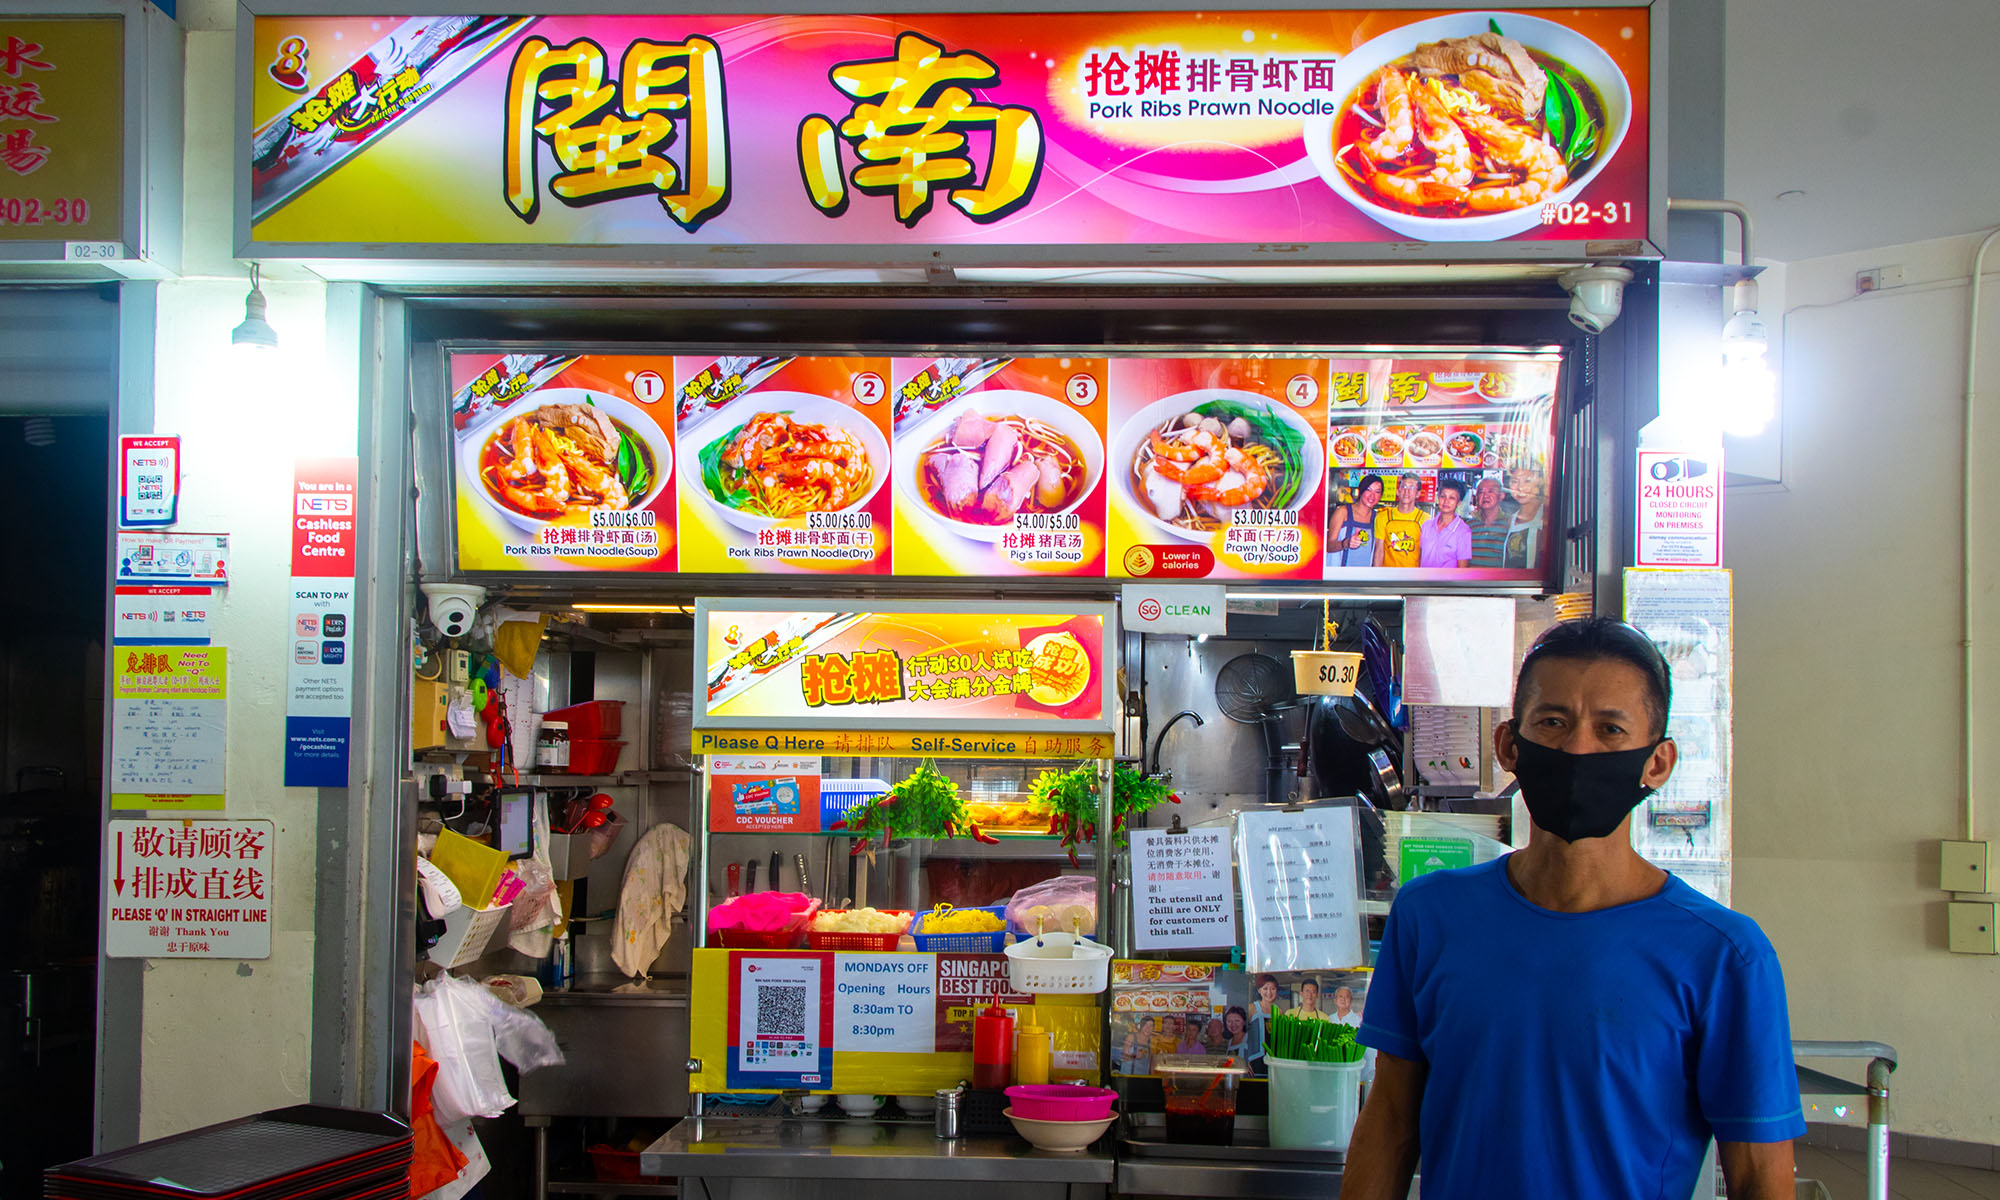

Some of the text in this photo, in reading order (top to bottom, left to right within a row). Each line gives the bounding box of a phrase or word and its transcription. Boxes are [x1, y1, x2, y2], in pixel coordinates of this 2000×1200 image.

[288, 66, 420, 133] 抢摊大行动
[1090, 98, 1334, 118] Pork Ribs Prawn Noodle
[1540, 202, 1632, 226] #02-31
[74, 244, 116, 258] 02-30
[643, 380, 652, 396] 1
[864, 381, 875, 396] 2
[1076, 382, 1088, 398] 3
[1296, 383, 1308, 399] 4
[298, 482, 316, 491] You
[336, 482, 345, 491] in
[1644, 485, 1714, 498] 24 HOURS
[302, 498, 348, 511] NETS
[296, 518, 352, 530] Cashless
[593, 512, 654, 528] $5.00/$6.00
[810, 513, 871, 529] $5.00/$6.00
[1016, 514, 1078, 530] $4.00/$5.00
[1234, 510, 1296, 526] $3.00/$4.00
[308, 532, 340, 543] Food
[1228, 529, 1300, 542] 虾面(干/汤)
[301, 545, 346, 557] Centre
[506, 546, 658, 557] Pork Ribs Prawn Noodle(Soup)
[729, 548, 873, 559] Pork Ribs Prawn Noodle(Dry)
[1226, 543, 1299, 553] Prawn Noodle
[1010, 550, 1082, 561] Pig's Tail Soup
[1162, 552, 1200, 560] Lower in
[1244, 552, 1299, 563] (Dry/Soup)
[1162, 561, 1199, 569] calories
[1141, 604, 1210, 616] SG CLEAN
[126, 652, 173, 675] 免排队
[908, 648, 1034, 677] 行动30人试吃
[802, 650, 903, 706] 抢摊
[1319, 664, 1354, 683] $0.30
[908, 672, 1034, 702] 大会满分金牌
[702, 734, 1105, 756] Please Q Here 请排队 Self-Service 自助服务
[132, 826, 264, 859] 敬请顾客
[132, 866, 264, 900] 排成直线
[1169, 895, 1202, 903] utensil
[112, 908, 152, 921] PLEASE
[171, 909, 182, 921] IN
[186, 909, 240, 922] STRAIGHT
[243, 910, 267, 922] LINE
[1194, 904, 1221, 913] ONLY
[1150, 917, 1163, 925] for
[1166, 916, 1215, 924] customers
[149, 926, 229, 937] 谢谢 Thank You
[1150, 928, 1168, 936] this
[844, 962, 928, 973] MONDAYS OFF
[838, 983, 930, 996] Opening Hours
[942, 980, 978, 994] BEST
[852, 1004, 913, 1015] 8:30am TO
[852, 1025, 895, 1037] 8:30pm
